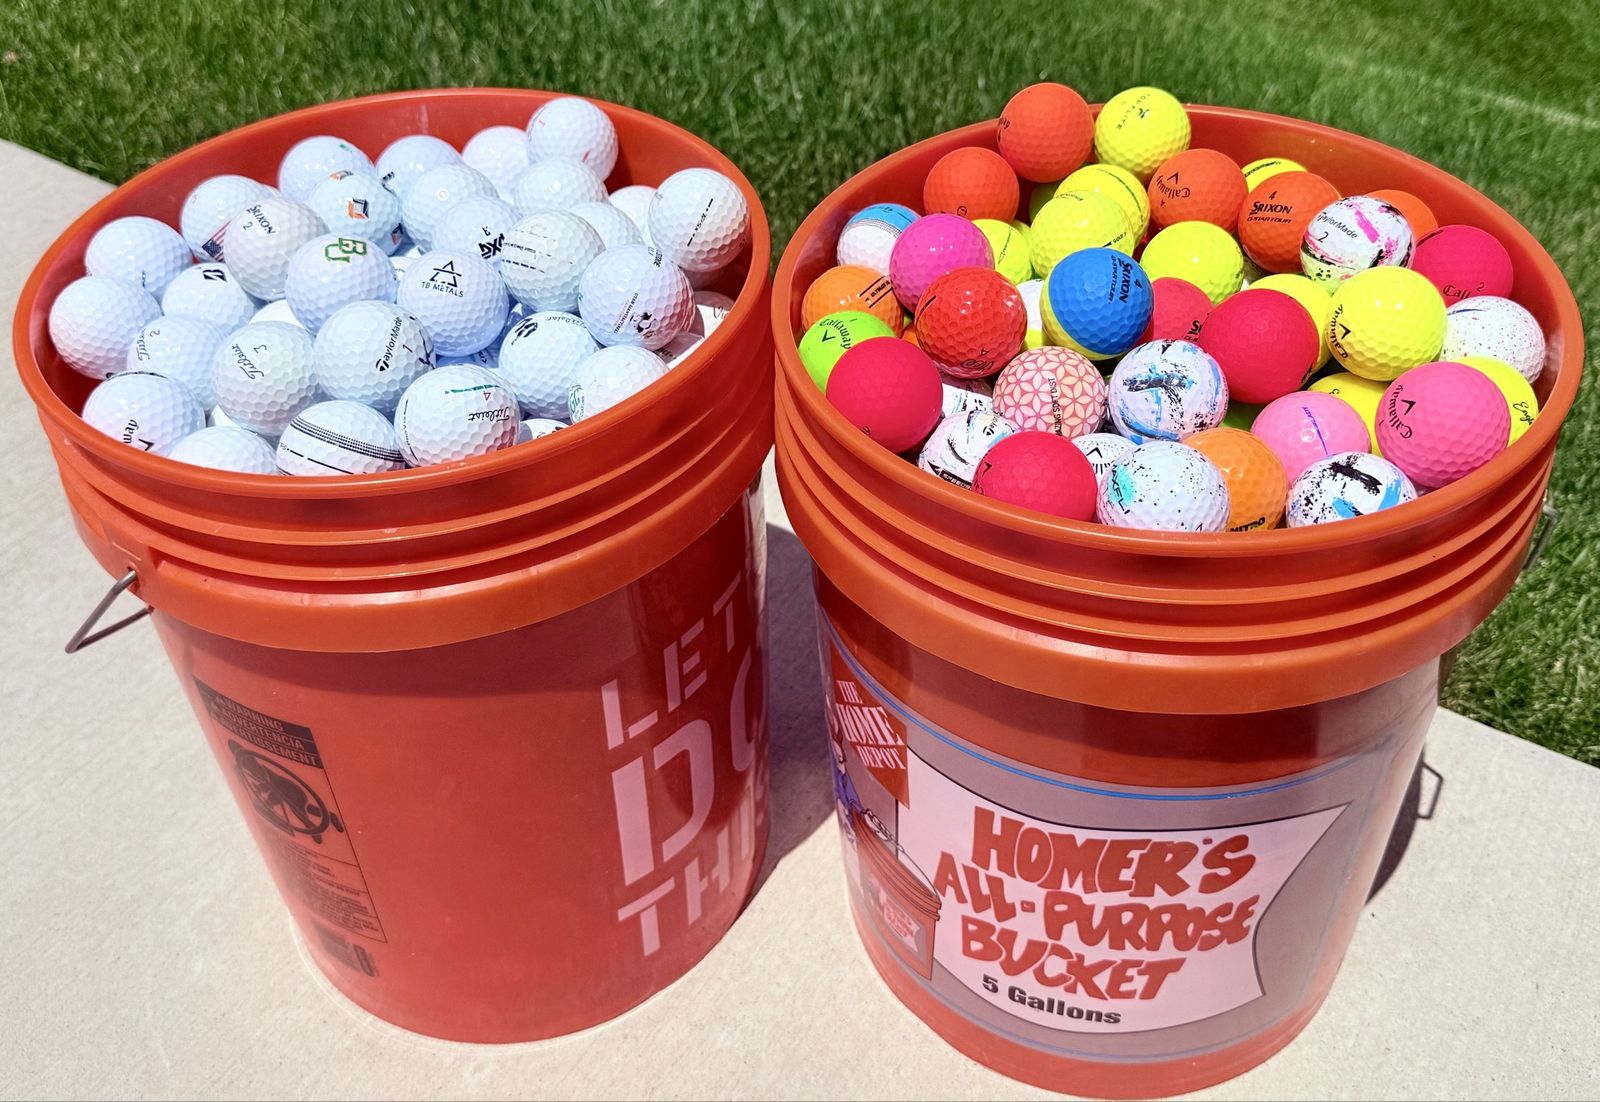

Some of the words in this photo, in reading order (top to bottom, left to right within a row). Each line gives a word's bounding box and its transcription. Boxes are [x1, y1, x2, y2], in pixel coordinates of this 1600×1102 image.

[1156, 175, 1191, 200] Callaway
[1268, 190, 1278, 201] 4
[246, 204, 276, 235] SRIXON
[1249, 201, 1293, 215] SRIXON
[242, 221, 253, 231] 2
[1316, 211, 1358, 240] TaylorMade
[1317, 231, 1329, 243] 2
[432, 283, 464, 299] METALS
[1117, 257, 1133, 303] SRIXON
[1134, 278, 1143, 289] 4
[1442, 284, 1472, 299] Call
[1476, 281, 1486, 293] 2
[375, 316, 403, 372] TaylorMade
[819, 318, 852, 350] Callaway
[1329, 304, 1349, 359] Callaway
[231, 343, 265, 380] Titleist
[253, 344, 267, 354] 3
[402, 344, 414, 353] 1
[468, 406, 510, 422] Titleist
[1388, 384, 1413, 439] Callaway
[838, 680, 863, 704] THE
[224, 699, 284, 732] WARNING
[835, 703, 905, 746] HOME
[856, 745, 906, 770] DEPOT
[970, 805, 1256, 898] HOMER'S
[933, 850, 1260, 952] ALL-PURPOSE
[961, 914, 1186, 1001] BUCKET
[981, 973, 999, 995] 5
[1007, 985, 1122, 1026] Gallons
